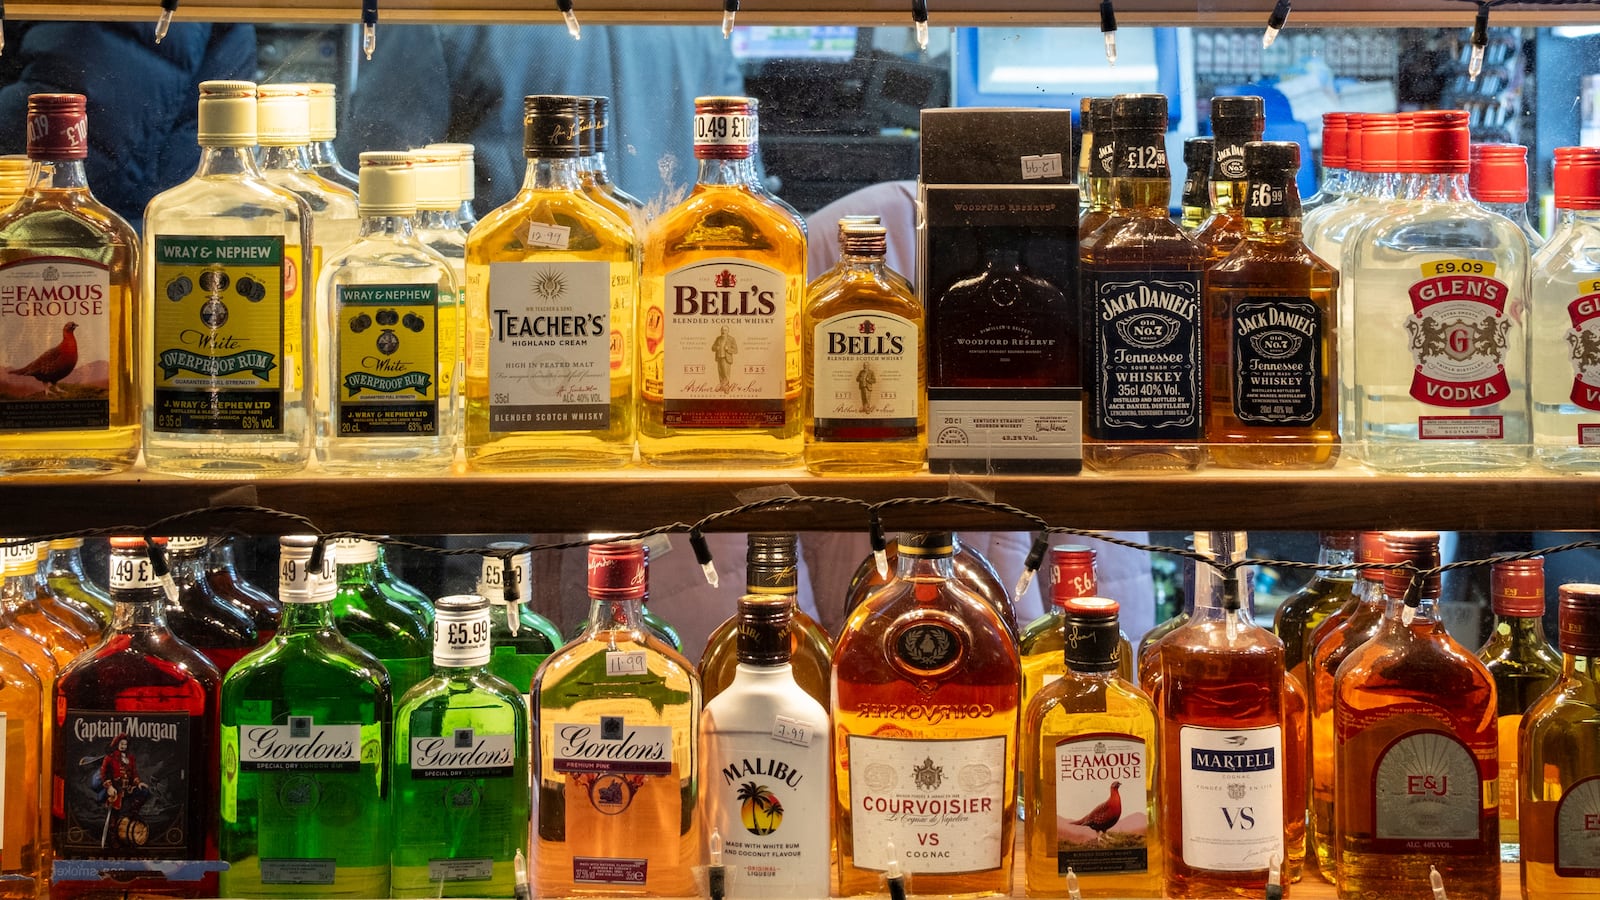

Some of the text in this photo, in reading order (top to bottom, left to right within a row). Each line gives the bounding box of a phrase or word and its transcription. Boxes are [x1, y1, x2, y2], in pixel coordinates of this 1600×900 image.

[164, 246, 271, 258] WRAY & NEPHEW
[1436, 263, 1483, 274] £9.09
[16, 285, 103, 301] FAMOUS
[344, 289, 431, 301] WRAY & NEPHEW
[1419, 280, 1498, 301] GLEN'S
[2, 286, 14, 317] THE
[673, 285, 776, 316] BELL'S
[1101, 286, 1197, 320] JACK DANIEL'S
[16, 301, 103, 317] GROUSE
[1237, 307, 1317, 337] JACK DANIEL'S
[180, 329, 250, 349] White
[1134, 326, 1162, 336] No.7
[827, 331, 904, 355] BELL'S
[1449, 329, 1469, 352] G
[361, 356, 414, 372] White
[1114, 349, 1183, 363] Tennessee
[164, 353, 268, 376] OVERPROOF RUM
[1249, 359, 1303, 370] Tennessee
[349, 374, 425, 390] OVERPROOF RUM
[1116, 372, 1183, 382] WHISKEY
[1251, 377, 1302, 385] WHISKEY
[1118, 384, 1180, 396] 35cl 40% Vol.
[1426, 382, 1498, 400] VODKA
[164, 400, 171, 408] J.
[172, 401, 197, 409] WRAY
[211, 401, 253, 409] NEPHEW
[255, 401, 271, 409] LTD
[494, 393, 509, 404] 35cl
[166, 415, 174, 427] 35
[415, 410, 427, 418] LTD
[494, 412, 604, 422] BLENDED SCOTCH WHISKY
[242, 416, 259, 429] 63%
[448, 620, 488, 644] £5.99
[74, 716, 177, 742] Captain Morgan
[248, 727, 353, 760] Gordon's
[560, 726, 664, 760] Gordon's
[417, 739, 511, 767] Gordon's
[1073, 752, 1140, 768] FAMOUS
[1061, 755, 1071, 781] THE
[1196, 753, 1271, 771] MARTELL
[722, 758, 803, 788] MALIBU
[1072, 766, 1140, 781] GROUSE
[1408, 776, 1447, 796] E&J
[863, 796, 992, 814] COURVOISIER
[1221, 807, 1255, 830] VS
[917, 833, 939, 846] VS
